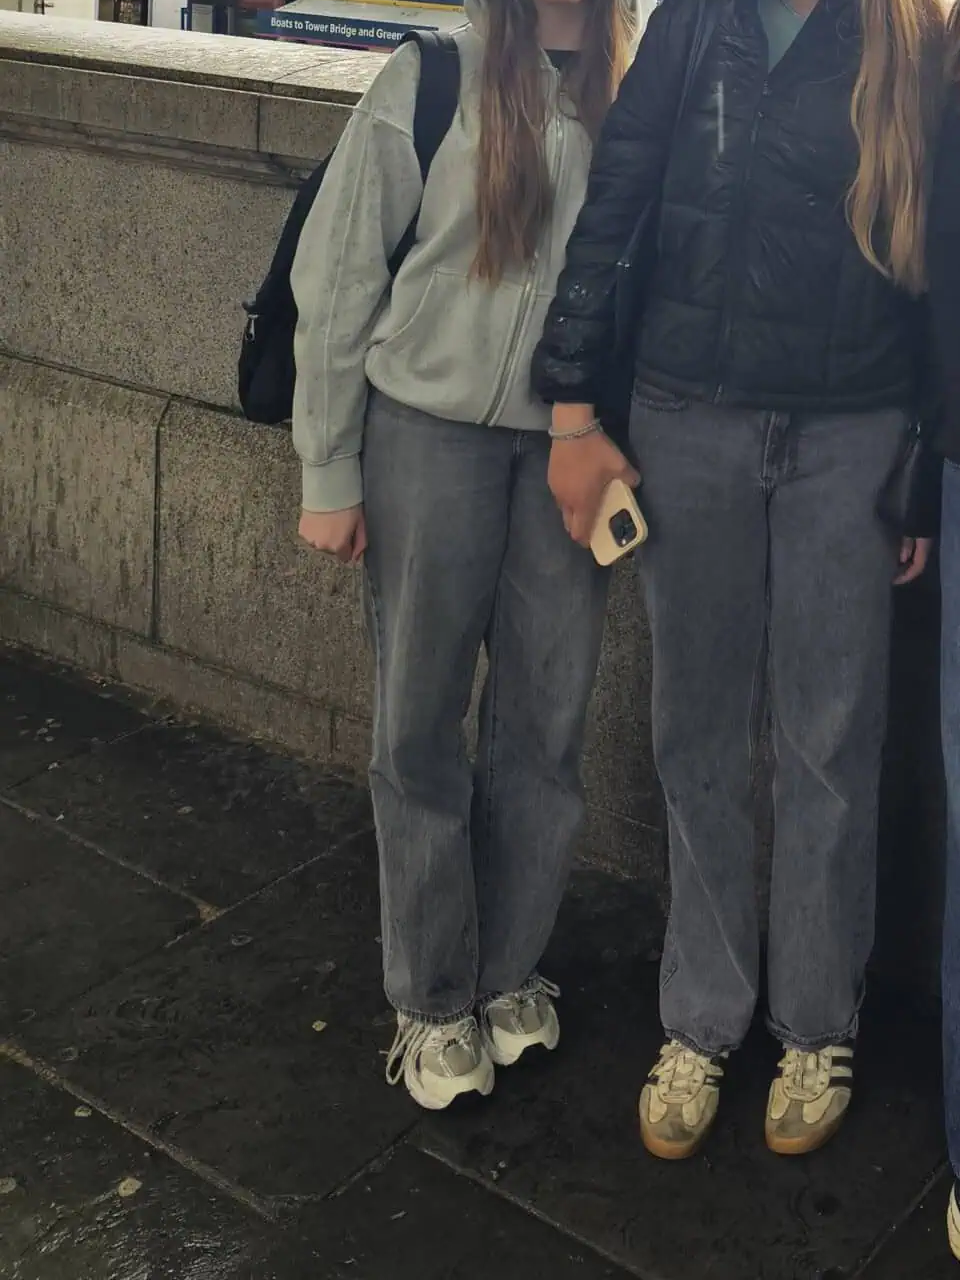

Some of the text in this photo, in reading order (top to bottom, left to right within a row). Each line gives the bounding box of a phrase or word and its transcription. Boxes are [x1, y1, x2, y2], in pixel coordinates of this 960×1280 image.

[271, 17, 404, 41] Boats to Tower Bridge and Green
